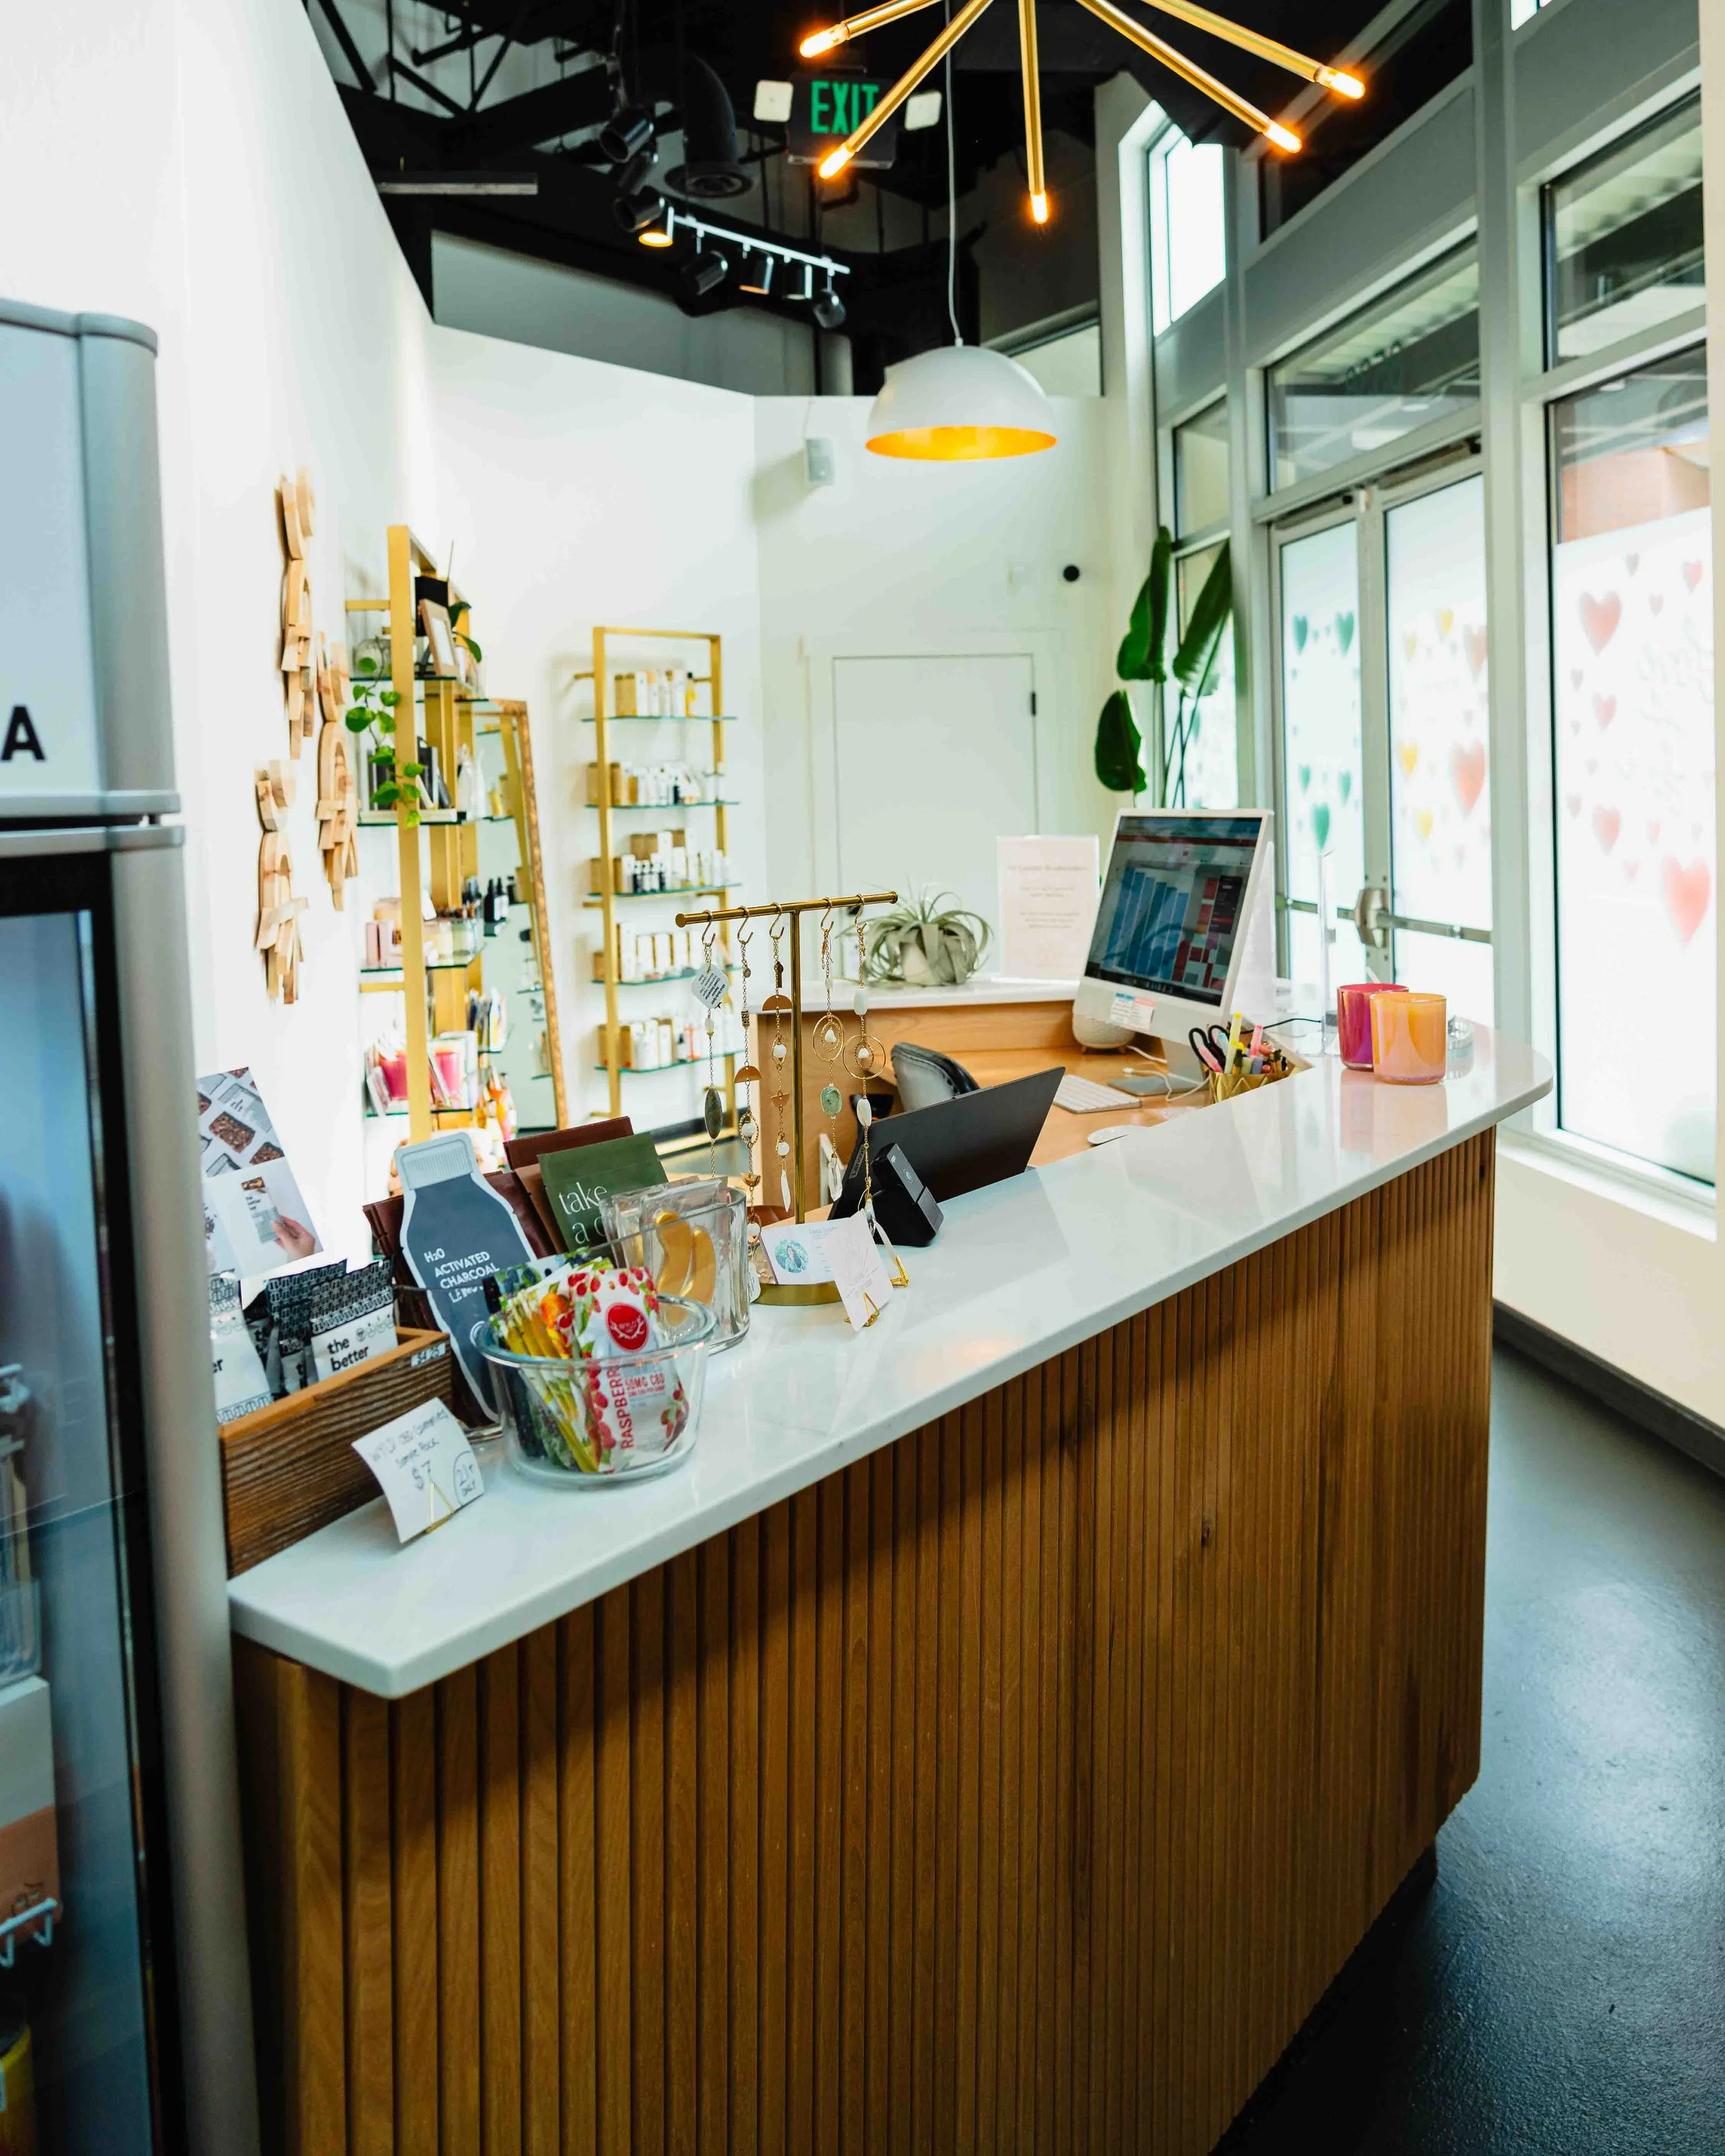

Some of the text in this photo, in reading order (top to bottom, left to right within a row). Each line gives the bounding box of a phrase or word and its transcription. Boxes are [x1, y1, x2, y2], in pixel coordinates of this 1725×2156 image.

[810, 79, 880, 135] EXIT
[1, 705, 46, 762] A
[558, 1181, 607, 1215] take
[572, 1222, 590, 1245] a
[433, 1251, 491, 1278] ACTIVATED
[440, 1263, 500, 1289] CHARCOAL
[326, 1337, 350, 1355] the
[330, 1345, 369, 1372] better
[607, 1363, 634, 1450] RASPBERR
